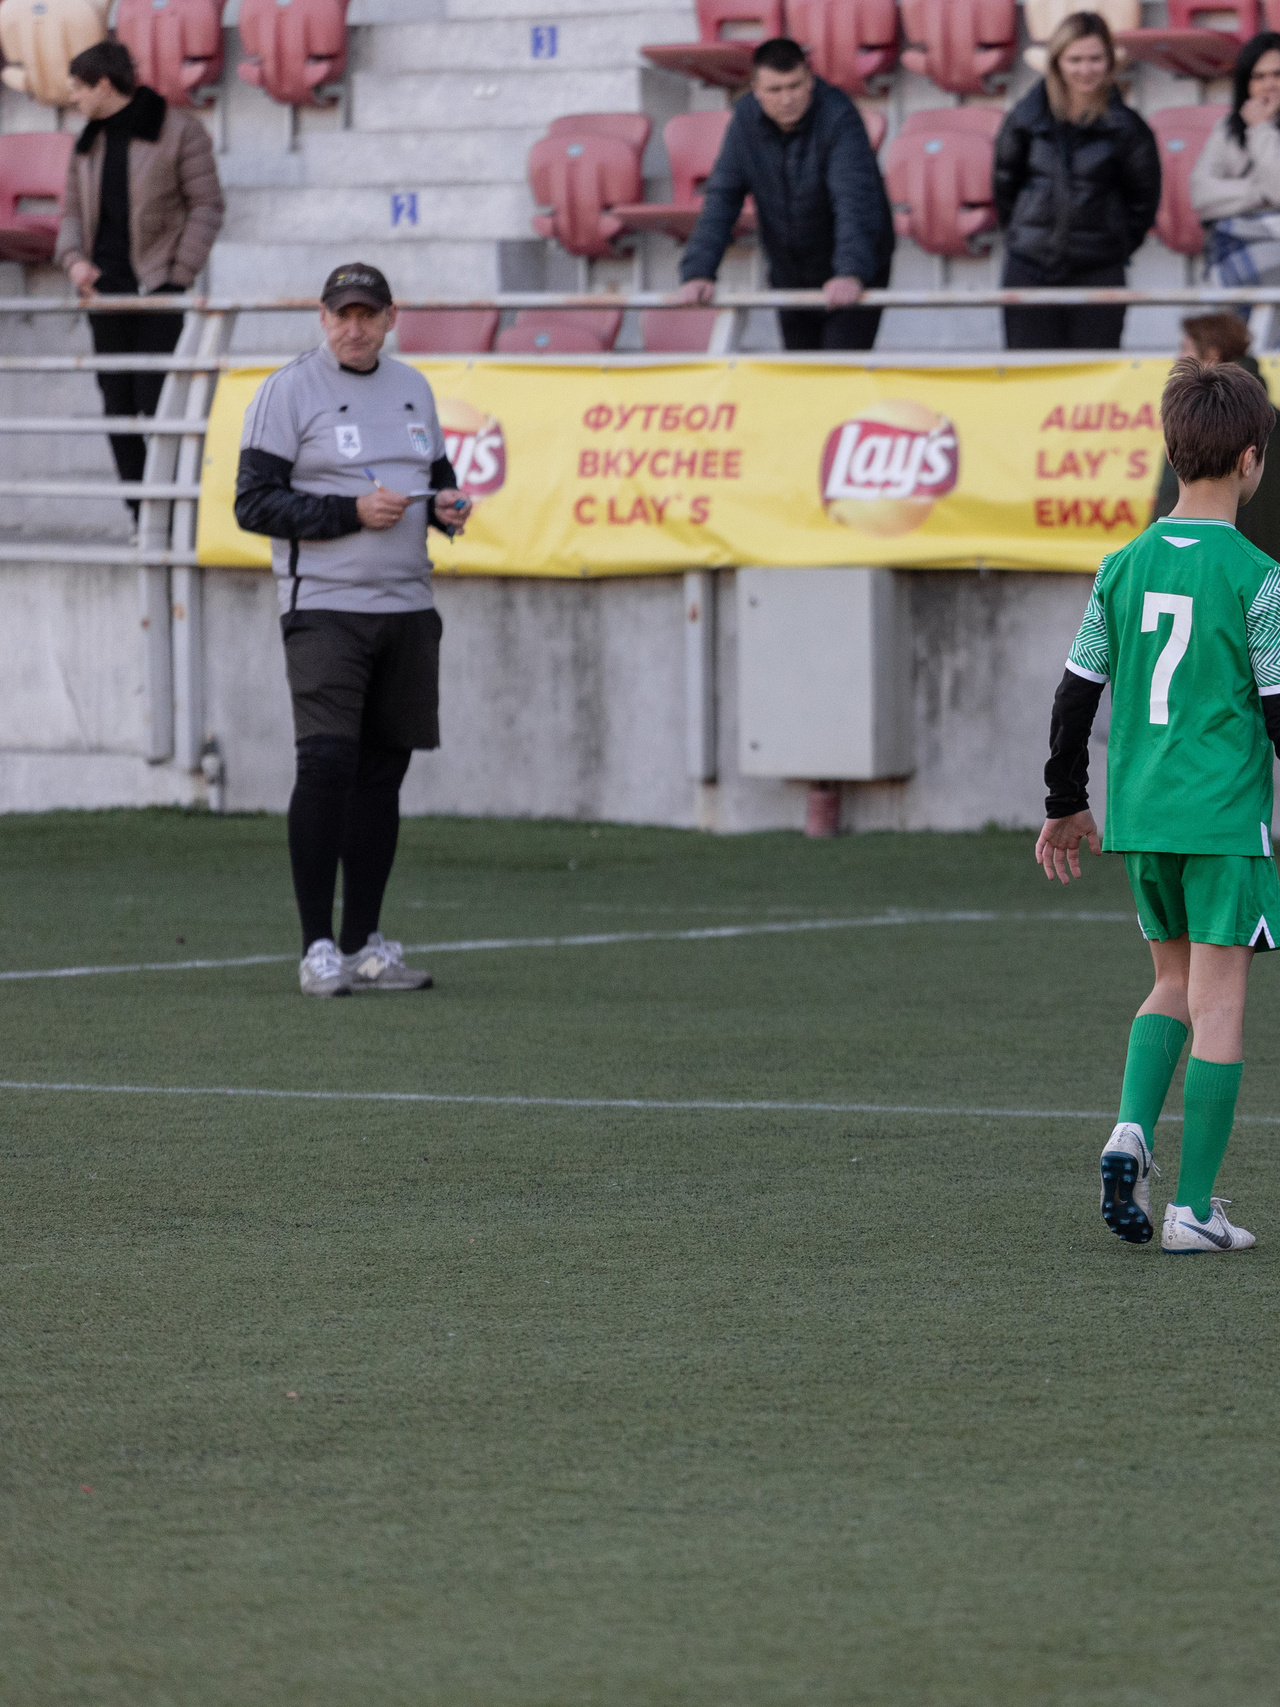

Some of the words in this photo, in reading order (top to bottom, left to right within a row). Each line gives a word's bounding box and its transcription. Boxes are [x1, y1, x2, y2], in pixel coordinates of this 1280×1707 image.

[582, 403, 737, 432] ФУТБОЛ
[577, 448, 742, 479] ВКУСНЕЕ
[1141, 591, 1194, 725] 7
